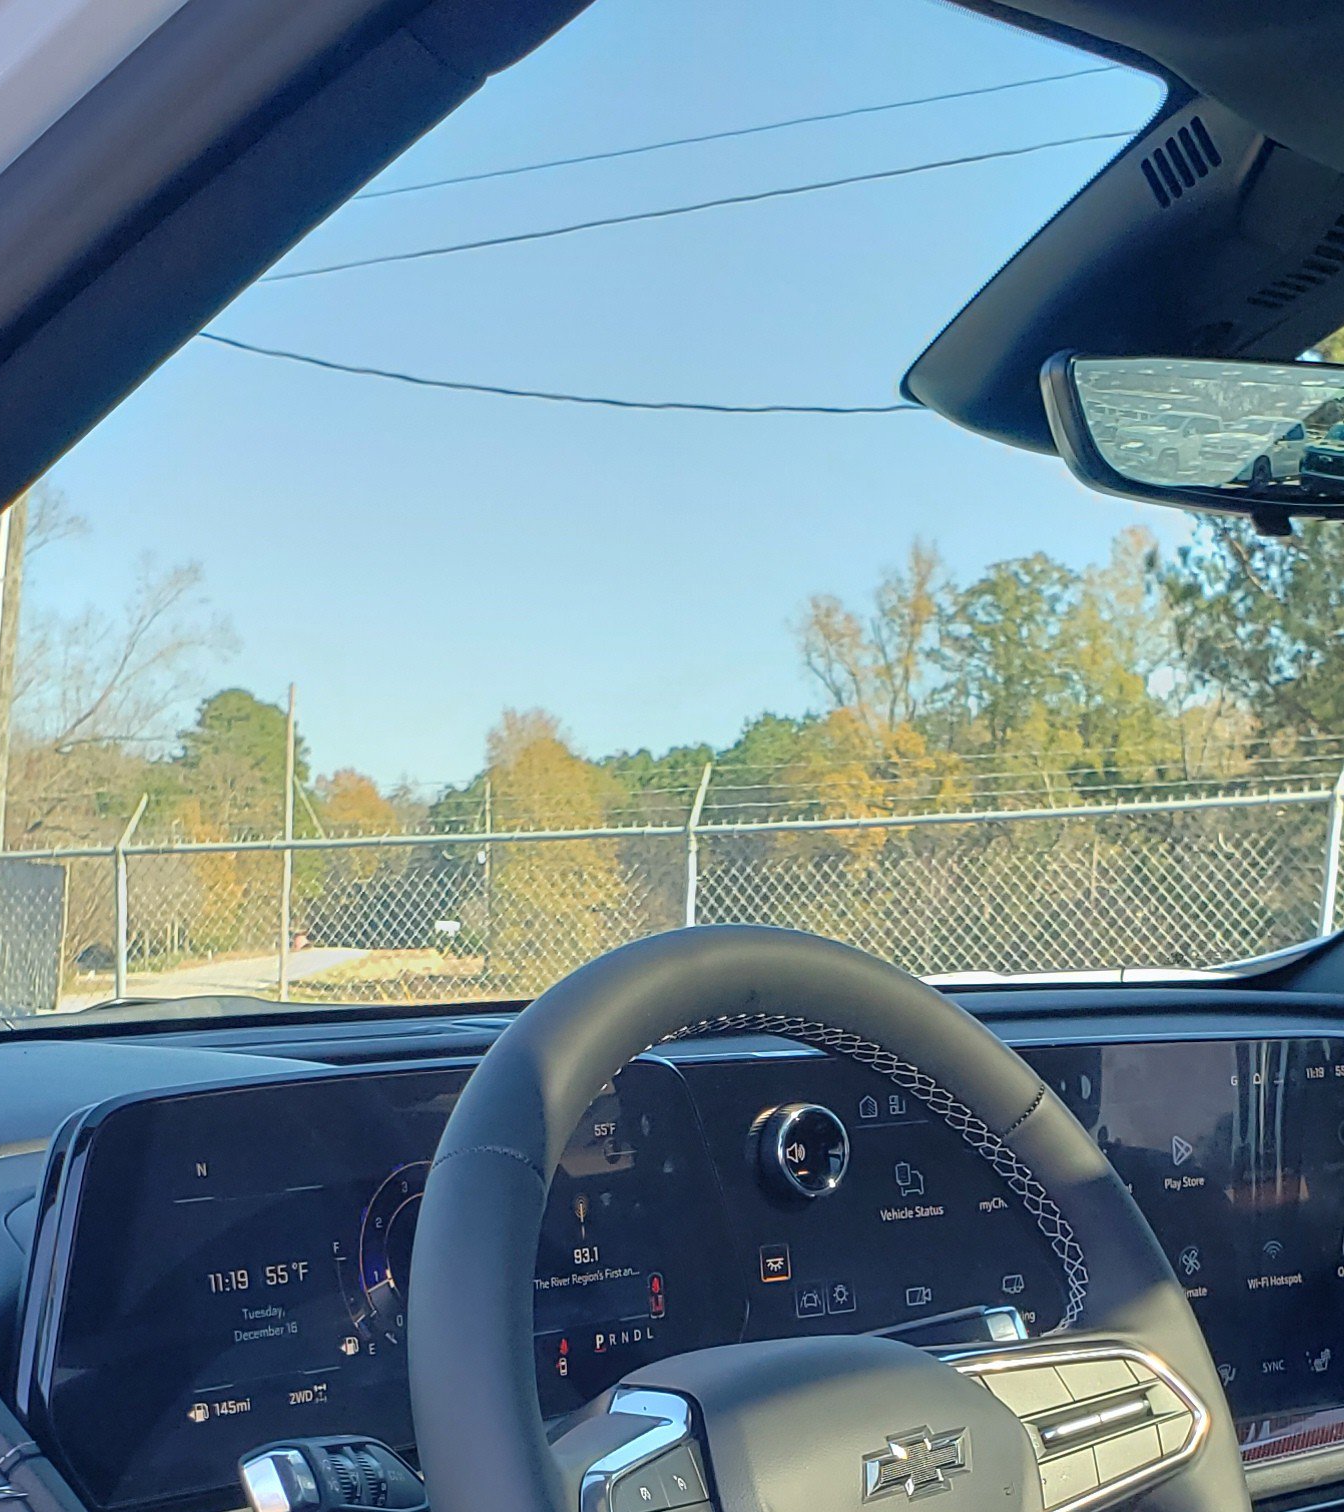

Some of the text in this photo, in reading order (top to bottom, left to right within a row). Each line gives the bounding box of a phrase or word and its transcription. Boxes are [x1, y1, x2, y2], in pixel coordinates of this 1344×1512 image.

[196, 1162, 207, 1177] N
[401, 1180, 409, 1193] 3
[1164, 1176, 1206, 1191] Play Store
[880, 1205, 944, 1221] Vehicle Status
[375, 1216, 384, 1229] 2
[333, 1241, 340, 1254] F
[573, 1246, 599, 1265] 93.1
[208, 1269, 249, 1294] 11:19
[373, 1270, 379, 1283] 1
[534, 1278, 550, 1290] The
[551, 1275, 571, 1288] River
[571, 1268, 604, 1286] Region's
[605, 1267, 622, 1279] First
[1247, 1273, 1303, 1290] Wi-Fi Hotspot
[234, 1324, 284, 1342] December
[368, 1343, 377, 1356] E
[1262, 1359, 1286, 1373] SYNC
[288, 1389, 313, 1405] 2WD
[214, 1398, 252, 1417] 145mi
